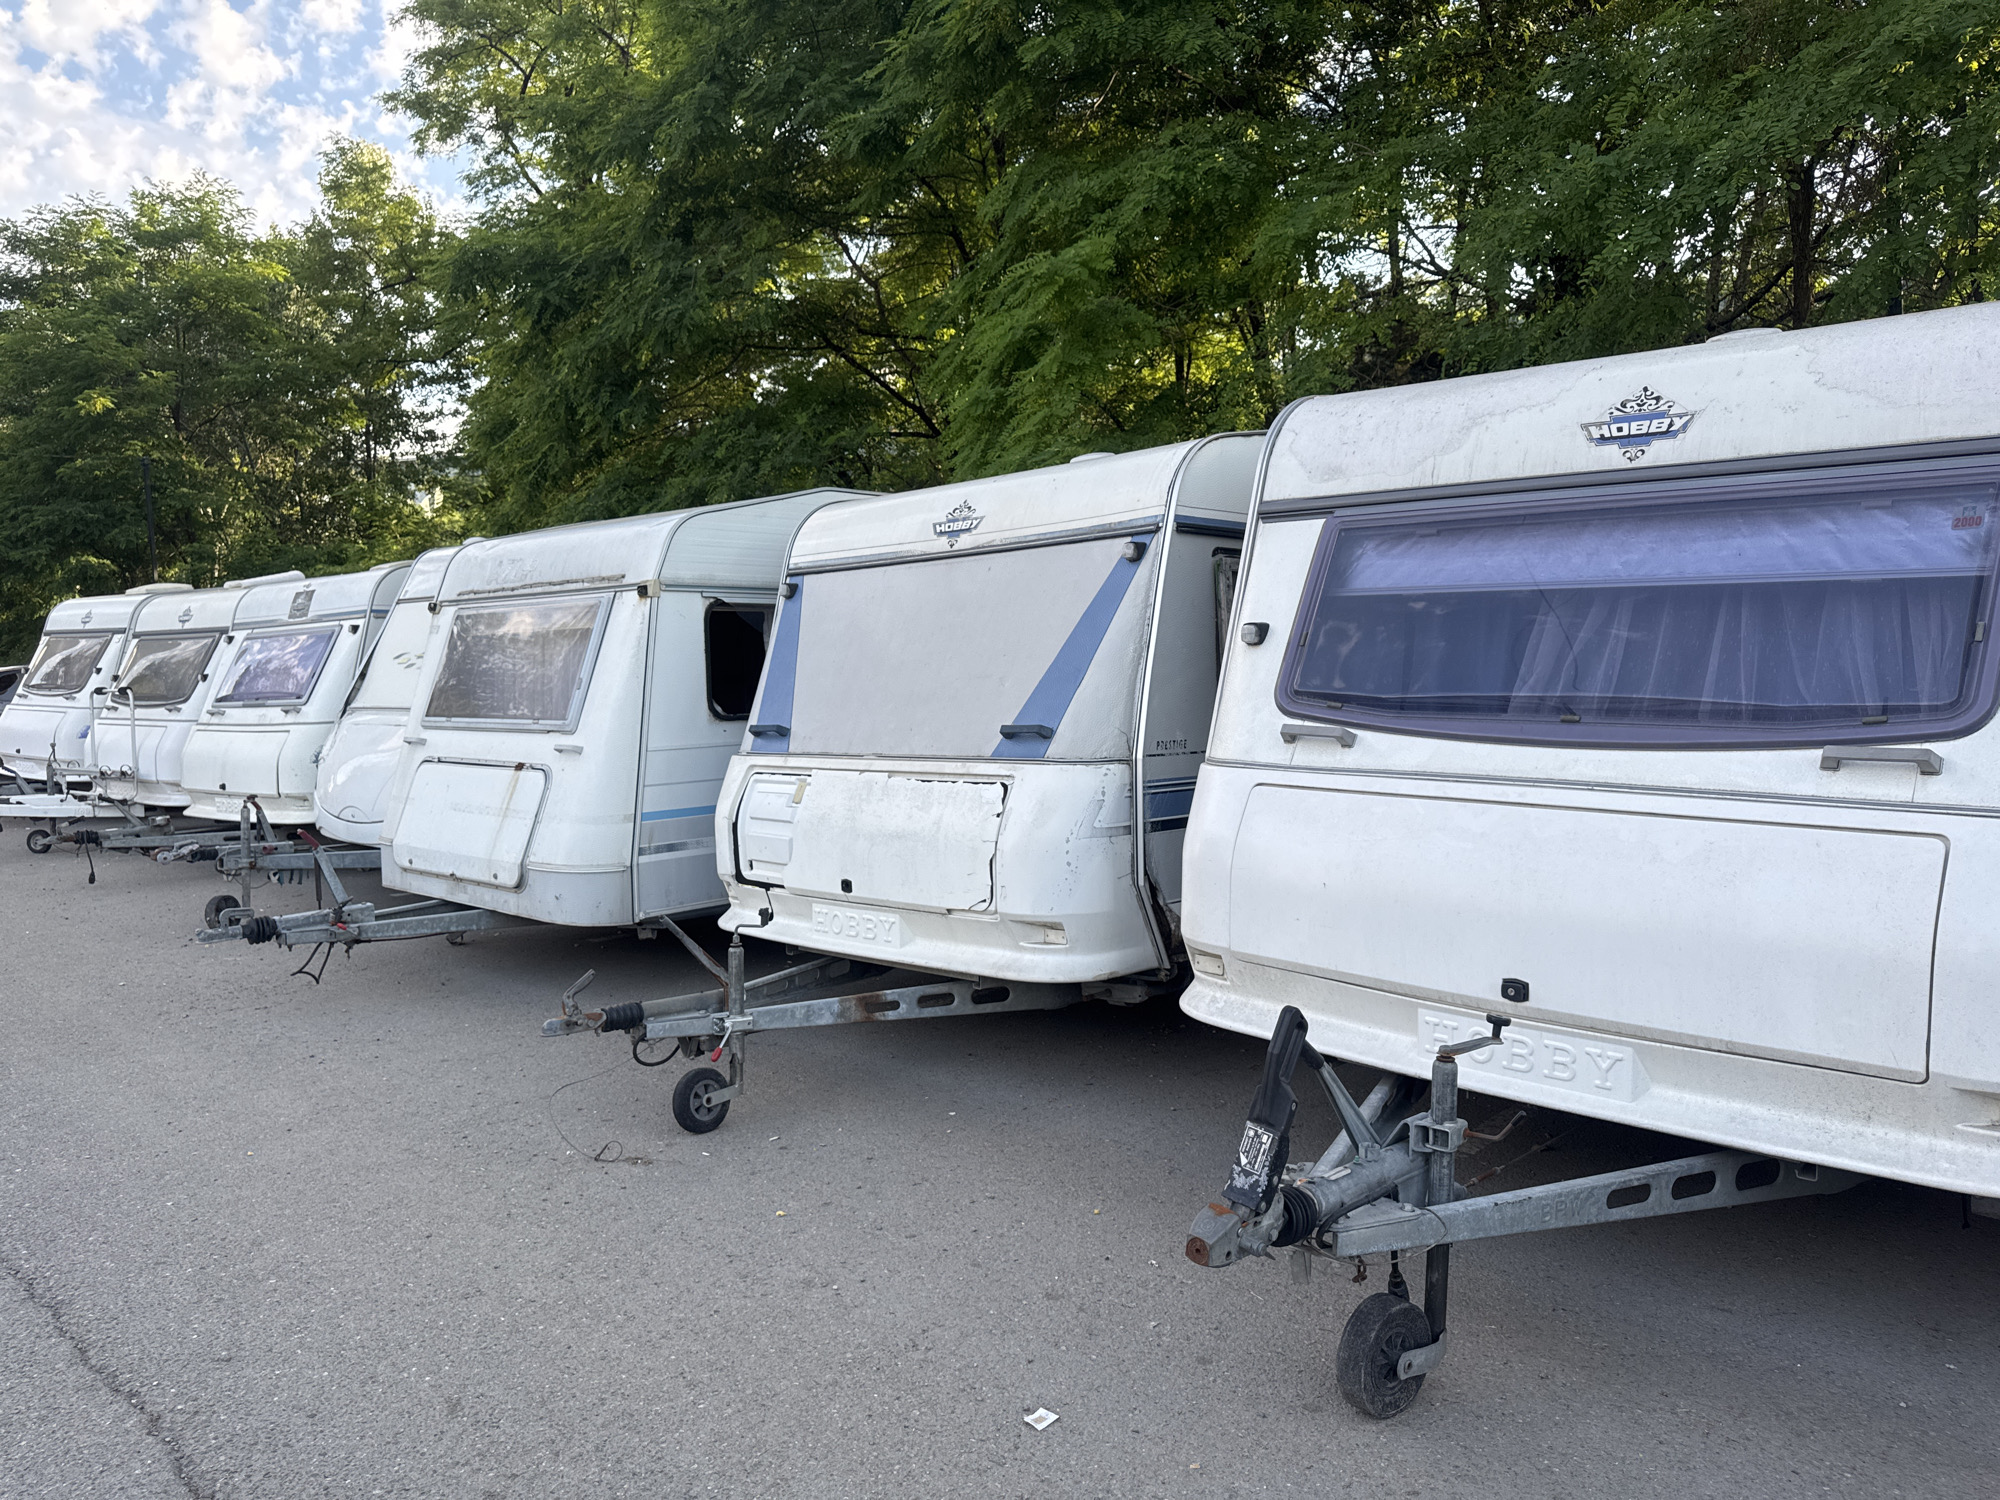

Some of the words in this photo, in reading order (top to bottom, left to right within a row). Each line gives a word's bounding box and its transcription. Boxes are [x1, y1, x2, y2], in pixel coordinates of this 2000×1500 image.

[1588, 414, 1694, 440] HOBBY
[935, 518, 981, 533] HOBBY
[1953, 515, 1983, 528] 2000
[1156, 739, 1187, 750] PRESTIGE
[813, 907, 896, 943] HOBBY
[1423, 1015, 1624, 1091] HOBBY
